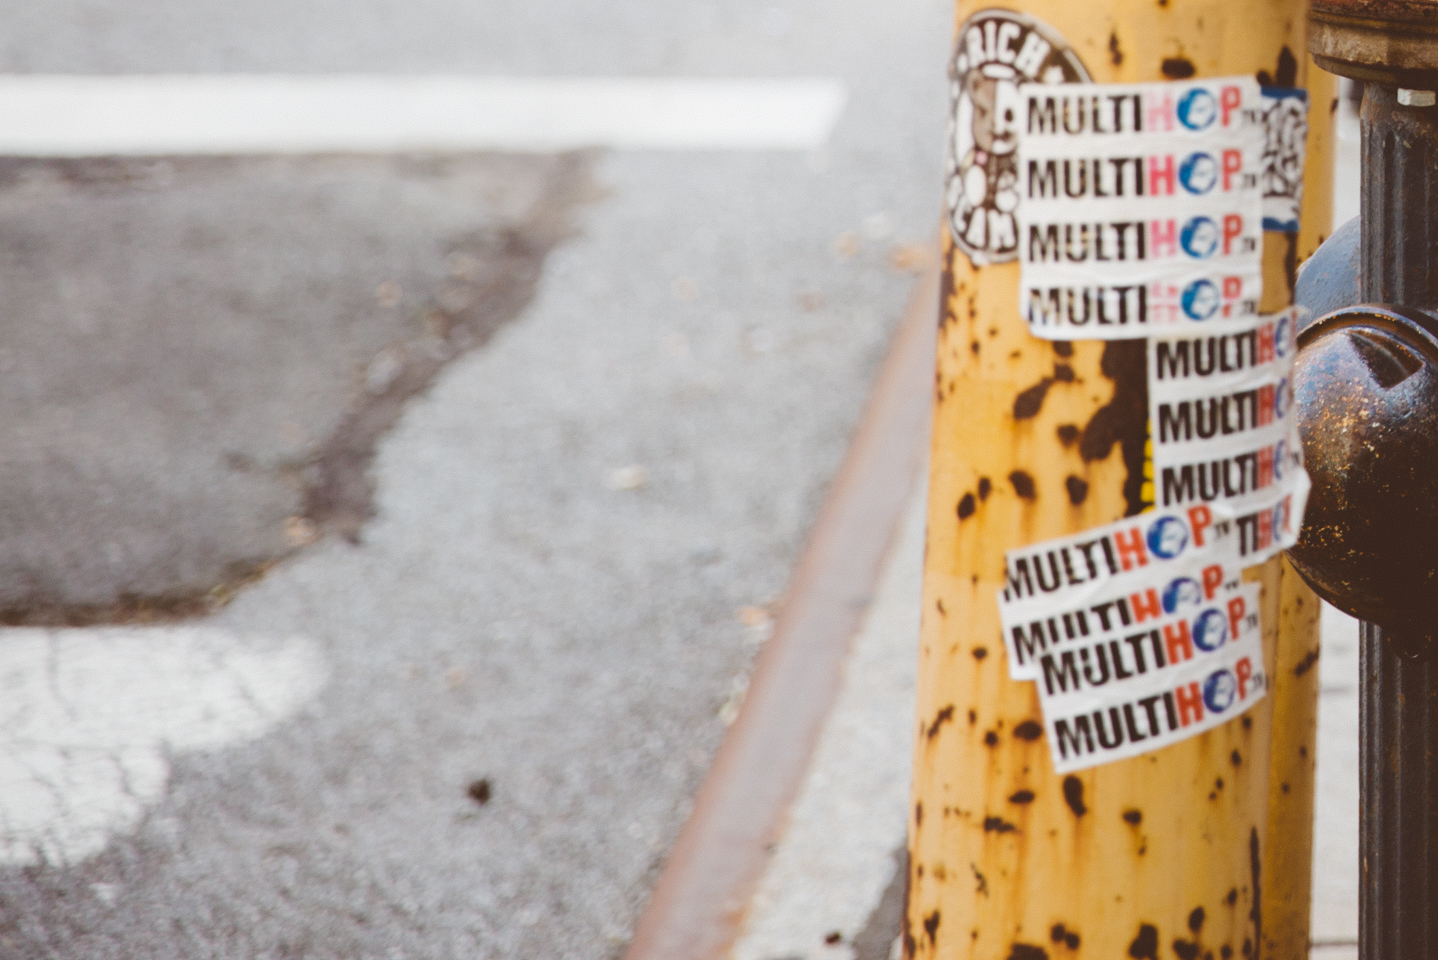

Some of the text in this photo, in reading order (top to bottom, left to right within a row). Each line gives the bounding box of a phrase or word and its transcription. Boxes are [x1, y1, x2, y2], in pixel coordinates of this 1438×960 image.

[1027, 149, 1243, 198] MULTIHOP
[1028, 213, 1244, 263] MULTIHOP
[1003, 504, 1212, 602] MULTIHOP
[1040, 596, 1246, 695] MULTIHOP
[1055, 656, 1252, 760] MULTIHOP
